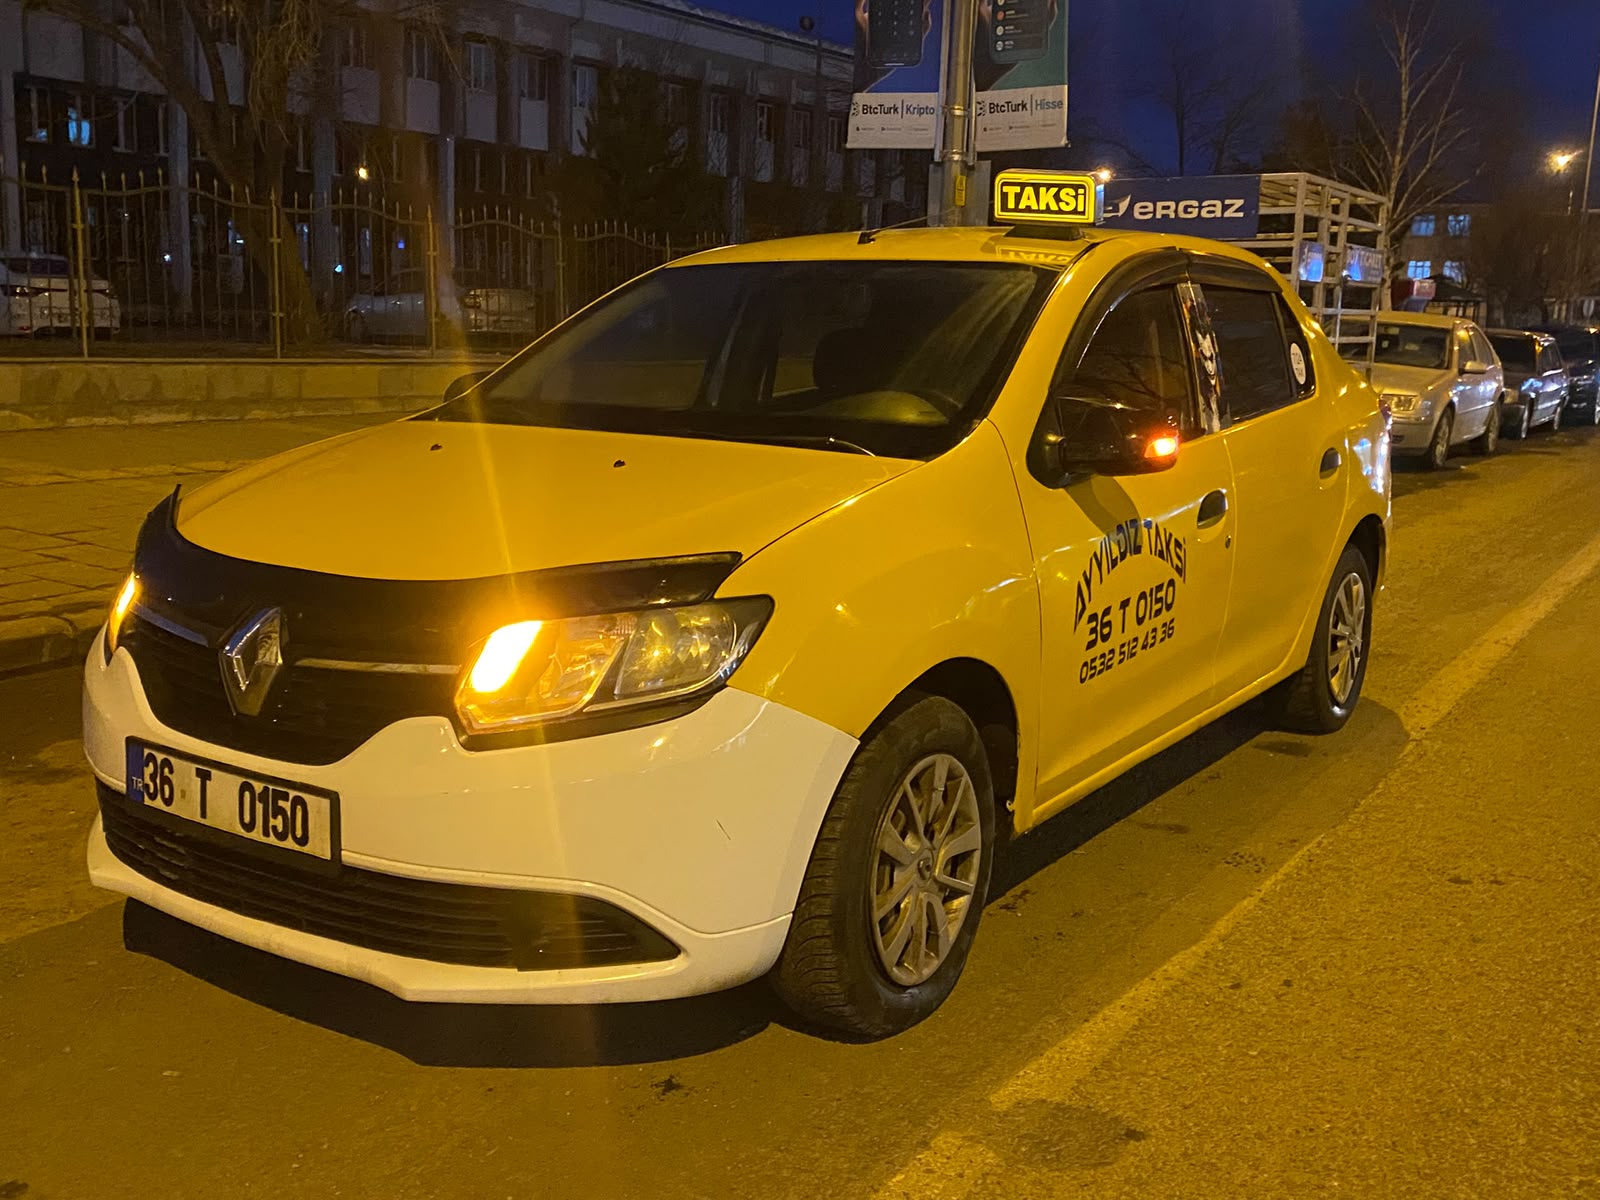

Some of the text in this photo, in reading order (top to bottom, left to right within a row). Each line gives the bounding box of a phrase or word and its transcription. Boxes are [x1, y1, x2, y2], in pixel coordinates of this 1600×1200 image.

[861, 103, 935, 117] BtcTurk Kripto
[988, 98, 1063, 114] BtcTurk Hisse
[1073, 518, 1142, 635] AYYILDIZ
[1085, 578, 1176, 651] 36 T 0150
[1079, 617, 1175, 684] 0532 512 43 36
[131, 776, 144, 793] TR
[143, 752, 309, 847] 36 T 0150
